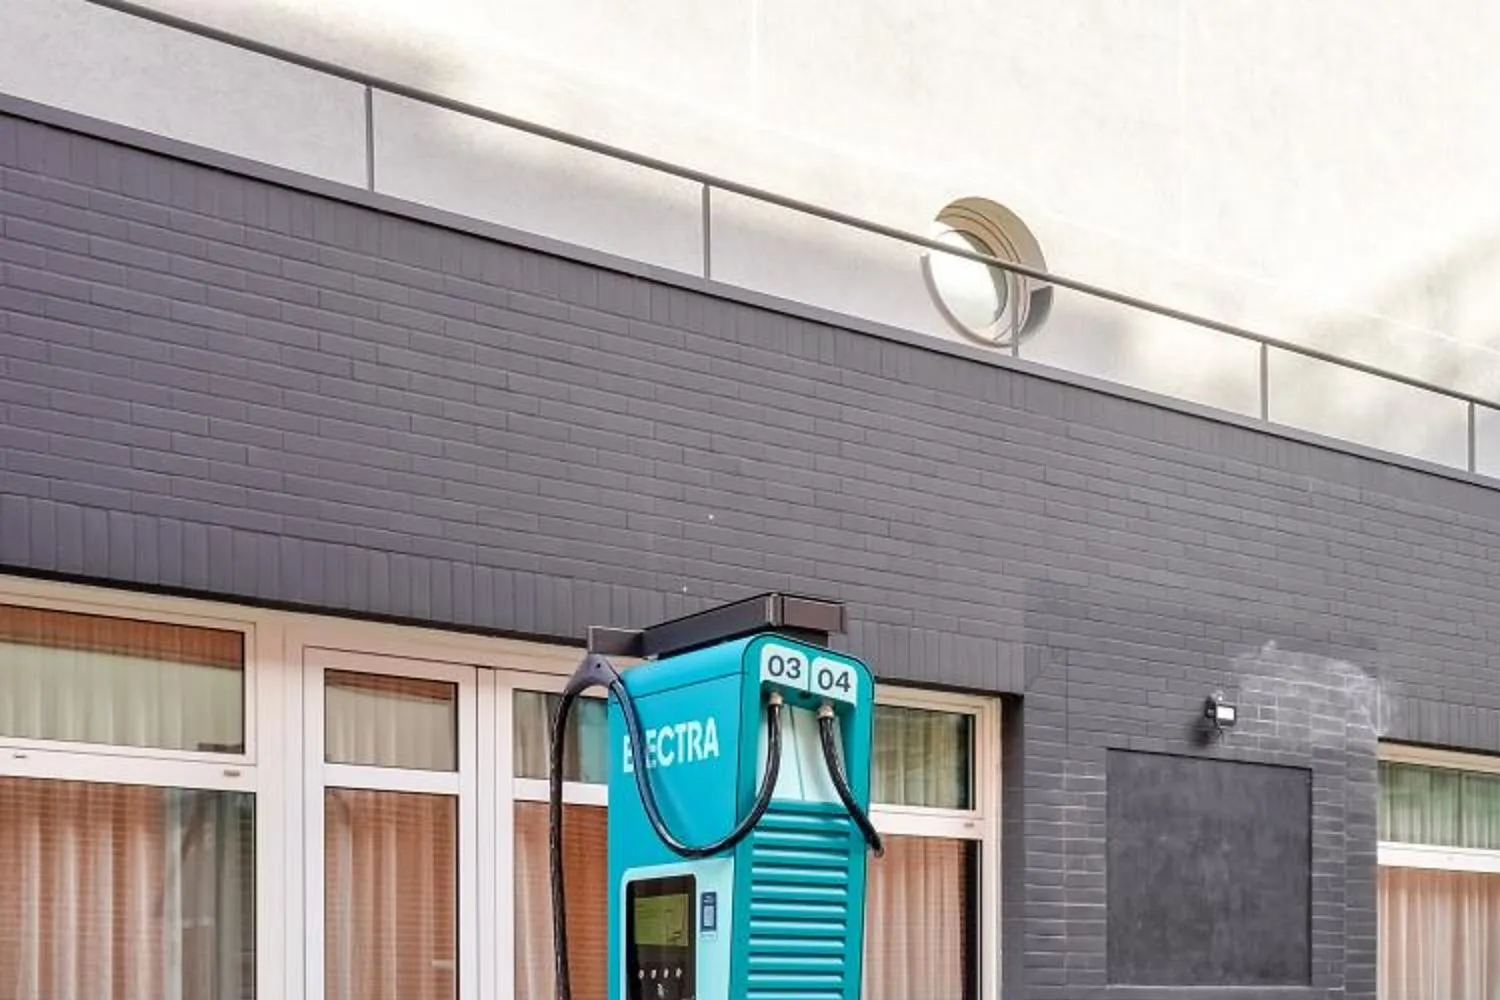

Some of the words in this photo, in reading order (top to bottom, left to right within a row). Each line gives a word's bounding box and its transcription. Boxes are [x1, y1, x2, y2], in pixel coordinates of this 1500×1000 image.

[768, 655, 801, 679] 03
[817, 668, 851, 693] 04
[623, 716, 720, 773] EECTRA
